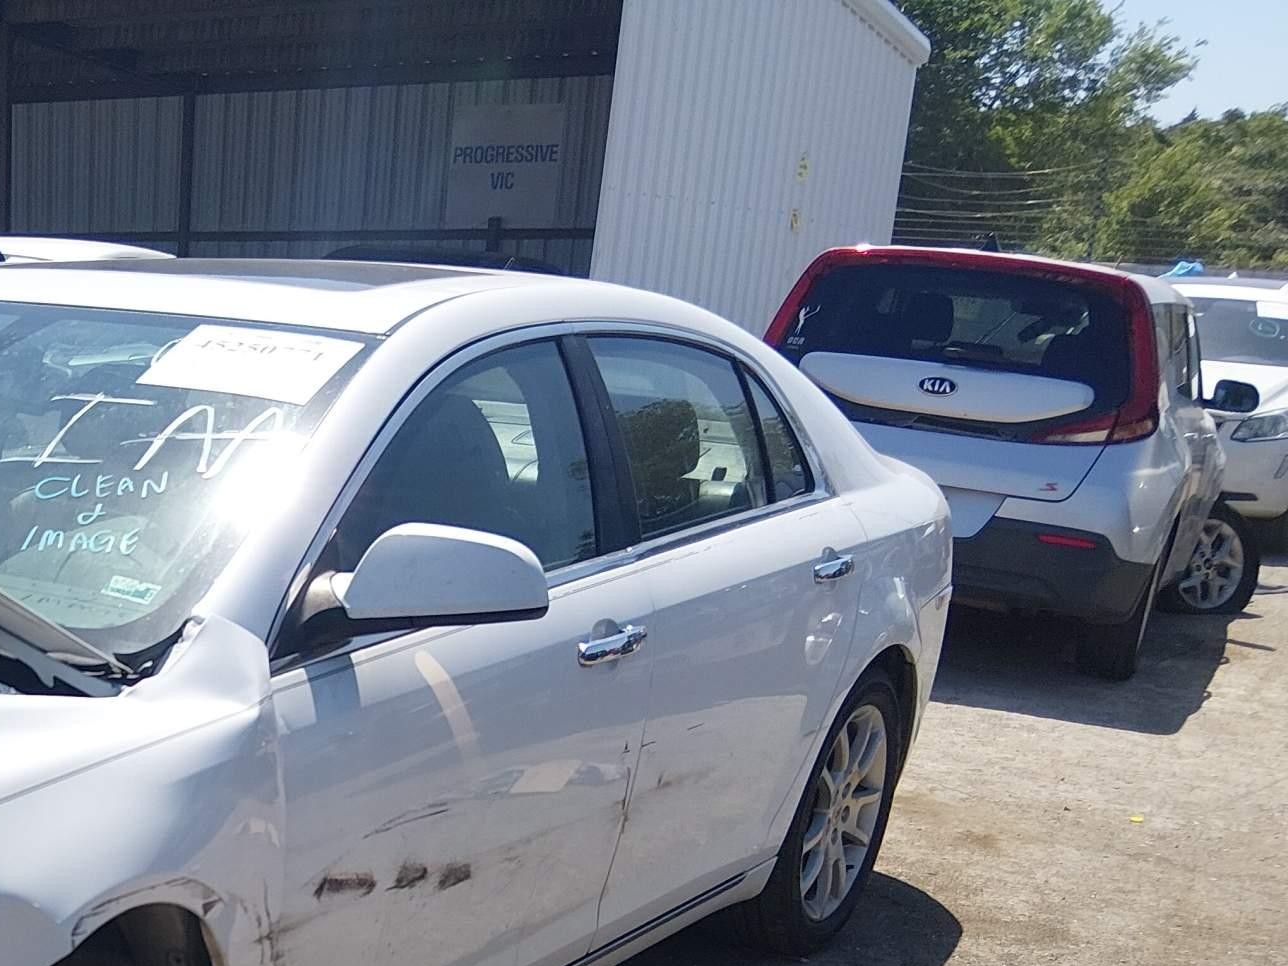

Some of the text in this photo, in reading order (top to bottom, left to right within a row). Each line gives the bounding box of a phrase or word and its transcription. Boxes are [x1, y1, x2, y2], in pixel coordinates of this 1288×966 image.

[453, 144, 560, 164] PROGRESSIVE
[490, 171, 514, 190] VIC
[923, 379, 951, 393] KIA
[34, 471, 169, 500] CLEAN
[20, 525, 141, 556] IMAGE
